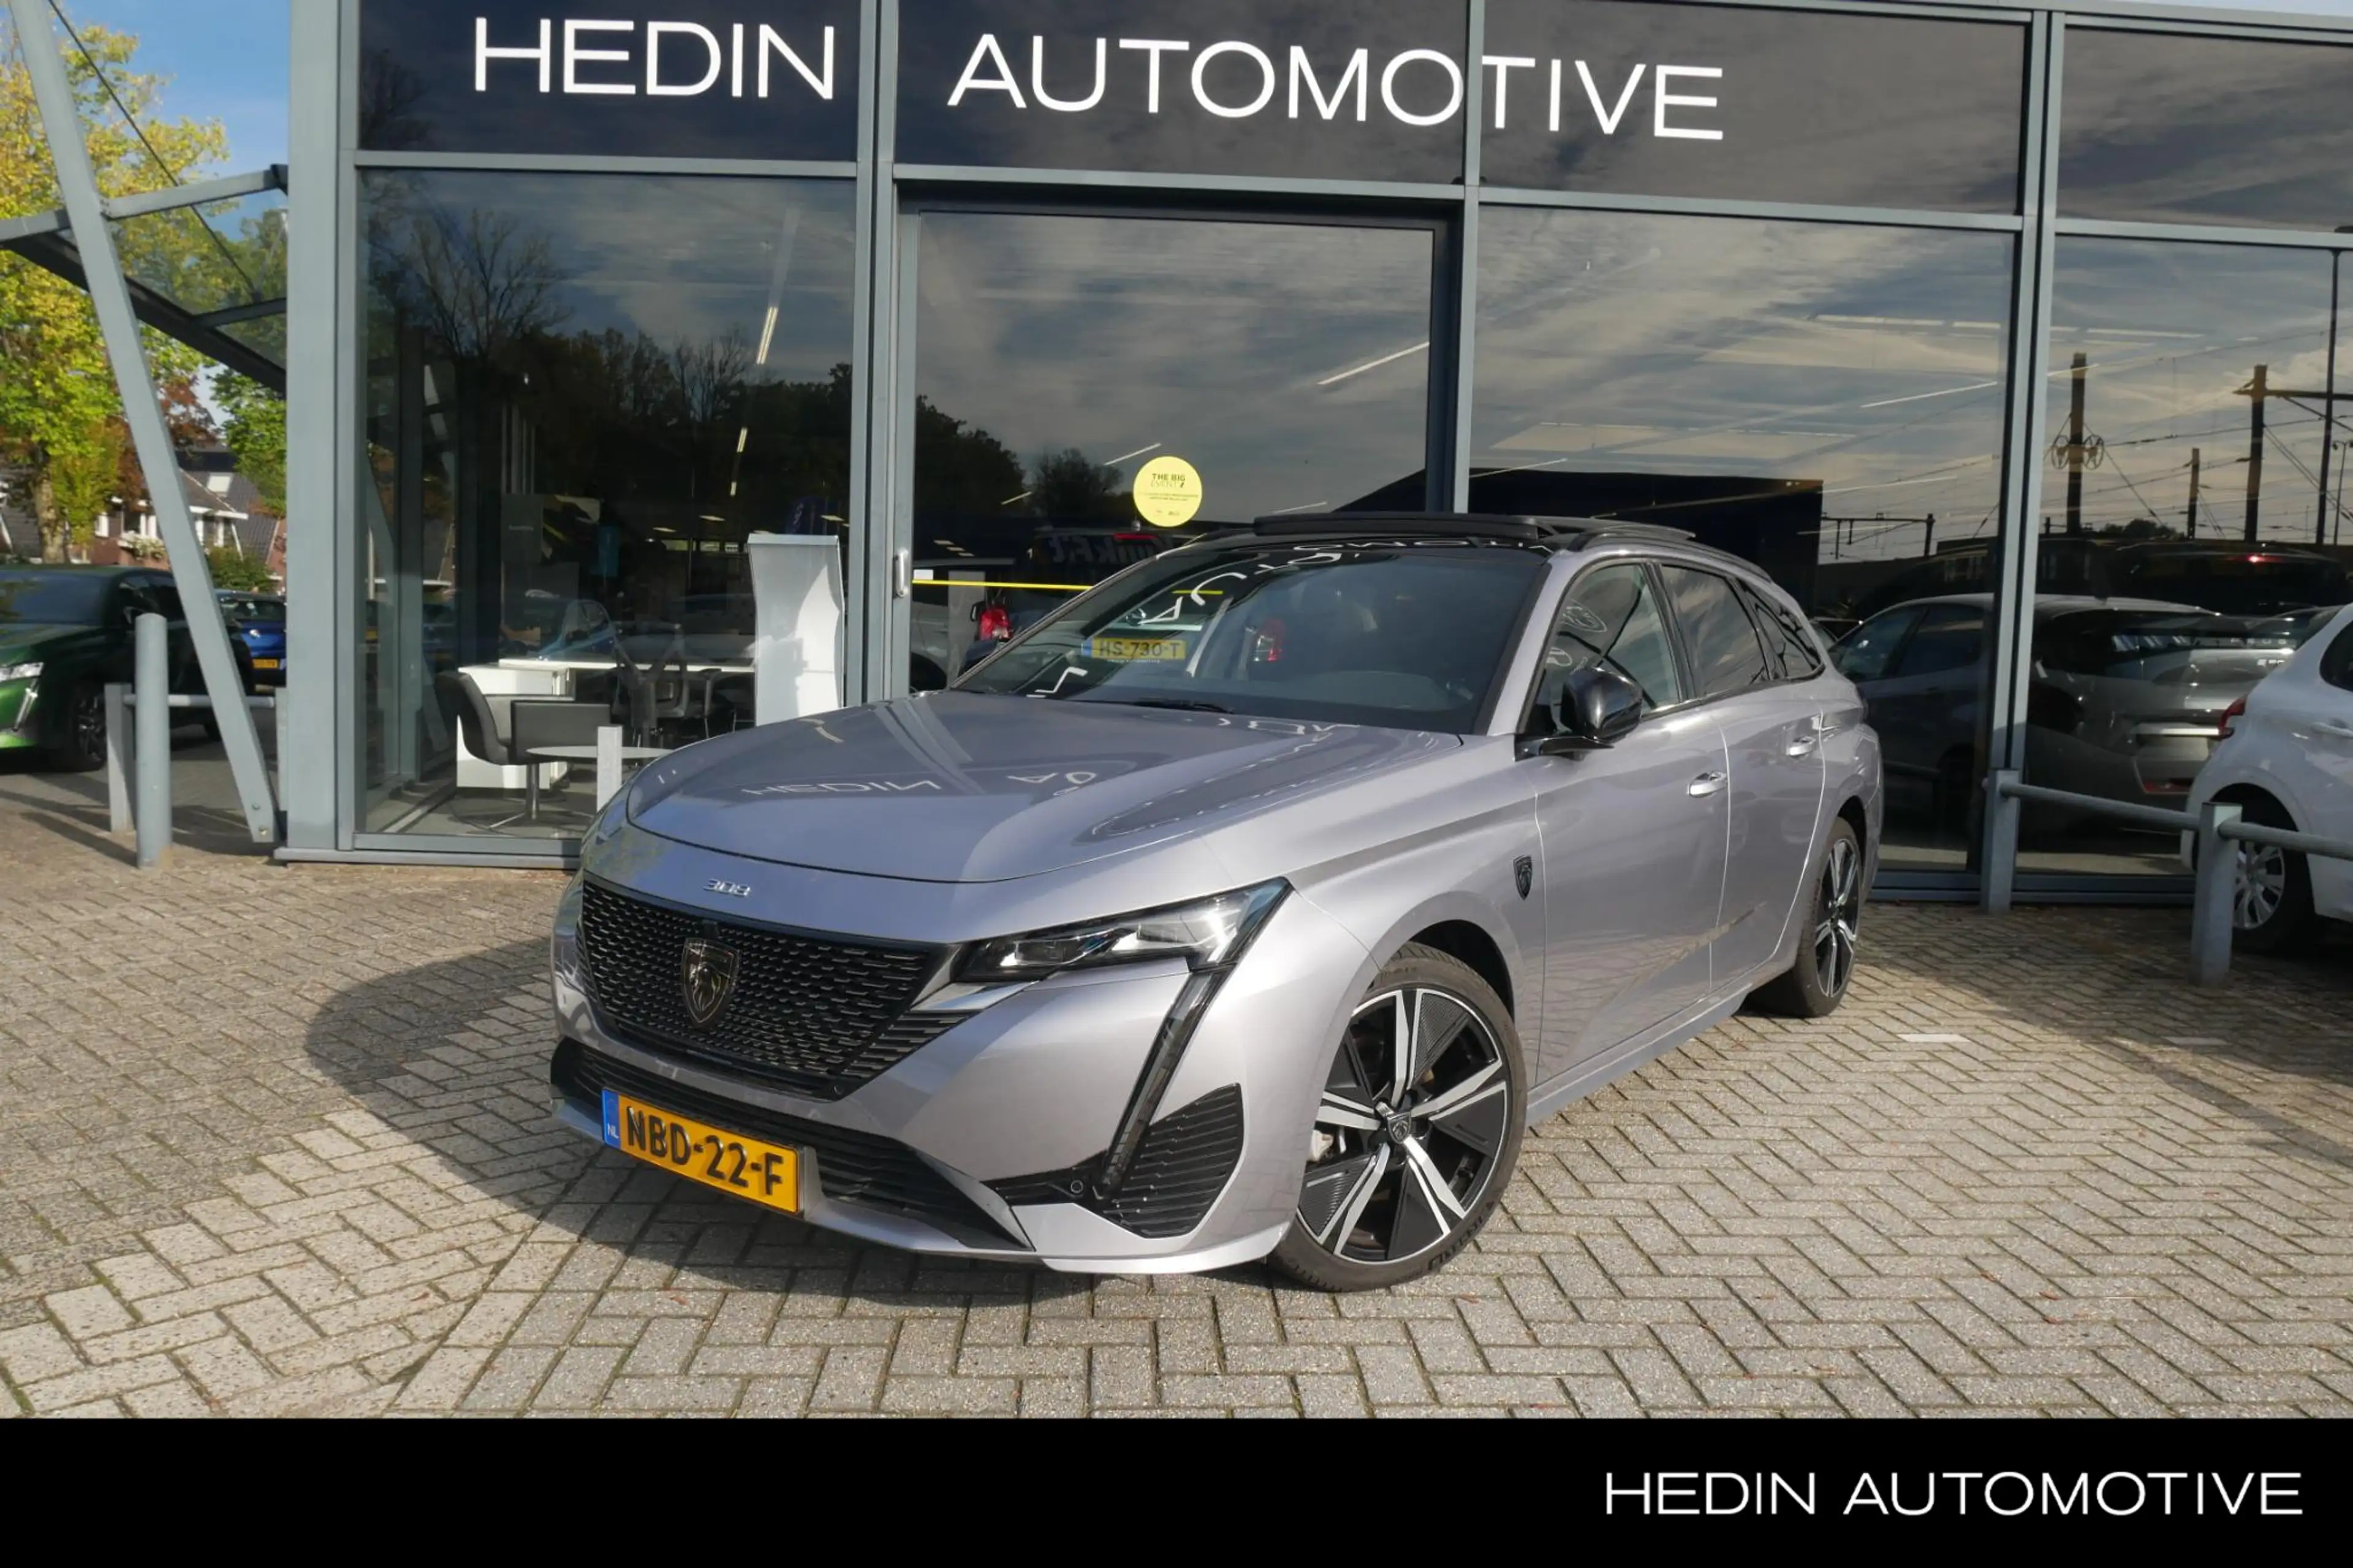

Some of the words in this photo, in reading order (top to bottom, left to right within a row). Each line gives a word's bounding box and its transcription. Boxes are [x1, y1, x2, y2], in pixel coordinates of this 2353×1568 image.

[476, 18, 833, 99] HEDIN
[948, 34, 1722, 139] AUTOMOTIVE
[1099, 641, 1181, 657] HS-730-T
[703, 879, 751, 896] 308
[607, 1123, 620, 1139] NL
[626, 1105, 784, 1195] NBD-22-F
